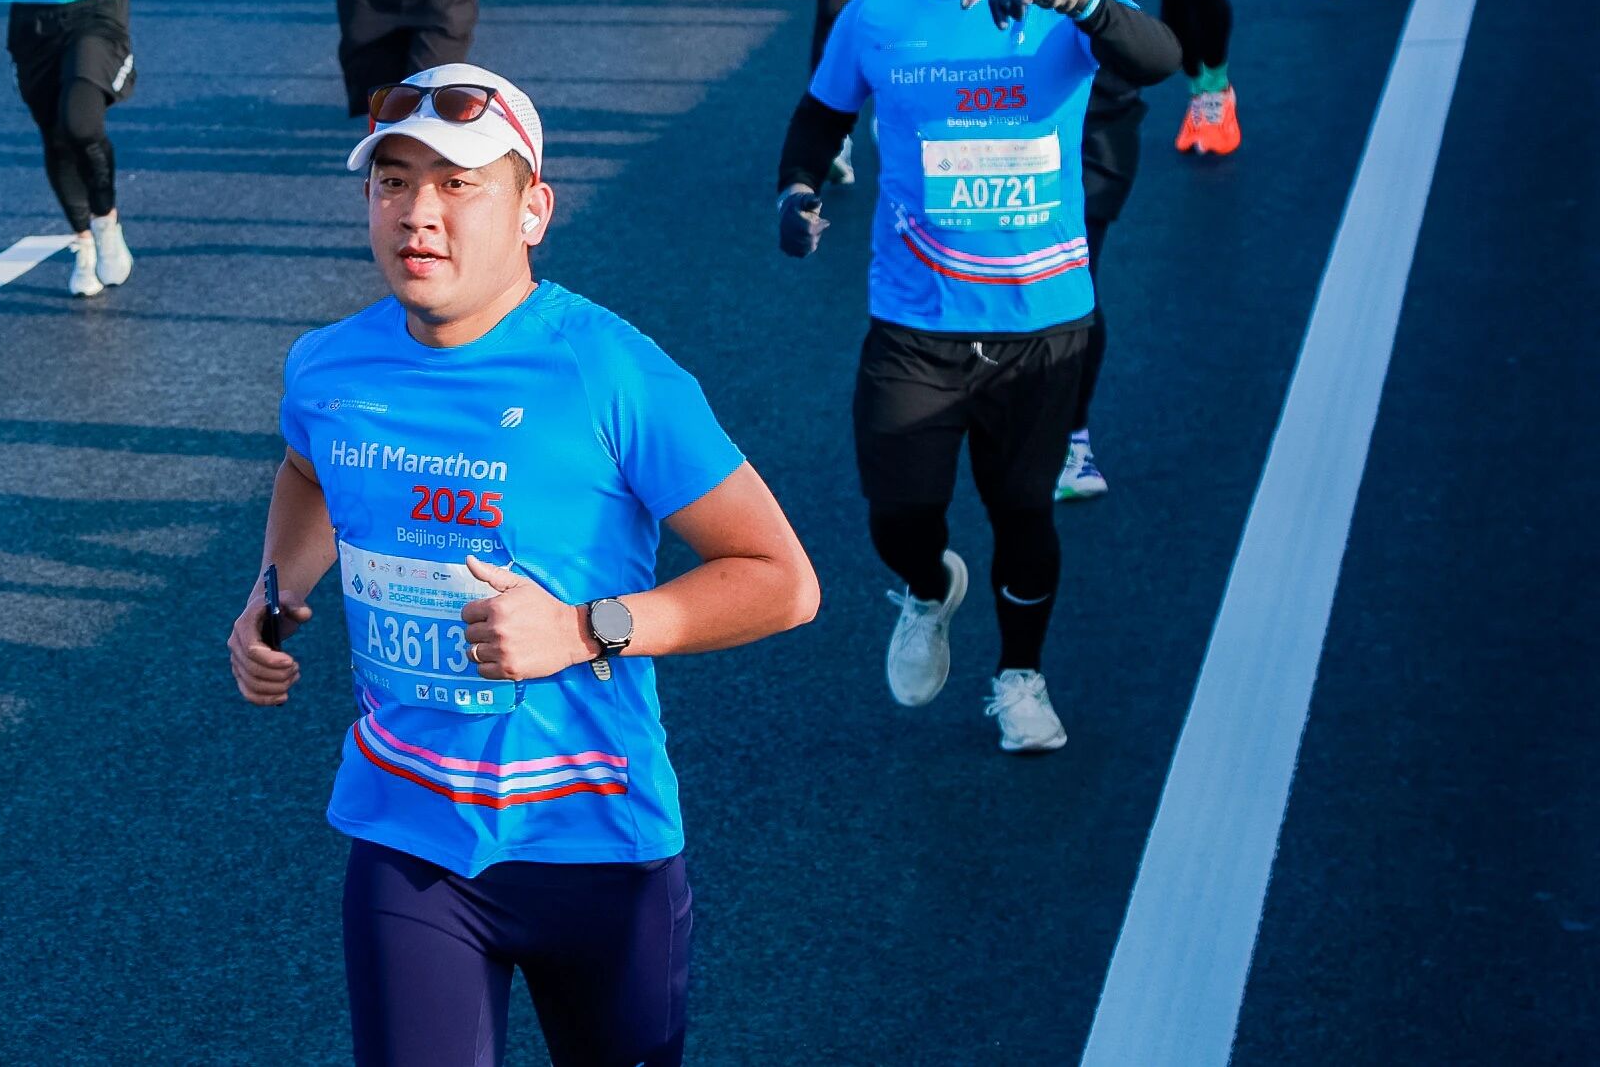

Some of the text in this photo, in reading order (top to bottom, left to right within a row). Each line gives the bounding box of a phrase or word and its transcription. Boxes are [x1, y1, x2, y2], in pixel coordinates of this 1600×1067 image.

[890, 65, 1025, 85] Half Marathon
[957, 85, 1027, 112] 2025
[946, 117, 987, 128] Beijing
[950, 176, 1036, 208] A0721
[331, 440, 507, 482] Half Marathon
[410, 485, 504, 528] 2025
[397, 527, 504, 553] Beijing Pinggu
[368, 610, 469, 673] A3613
